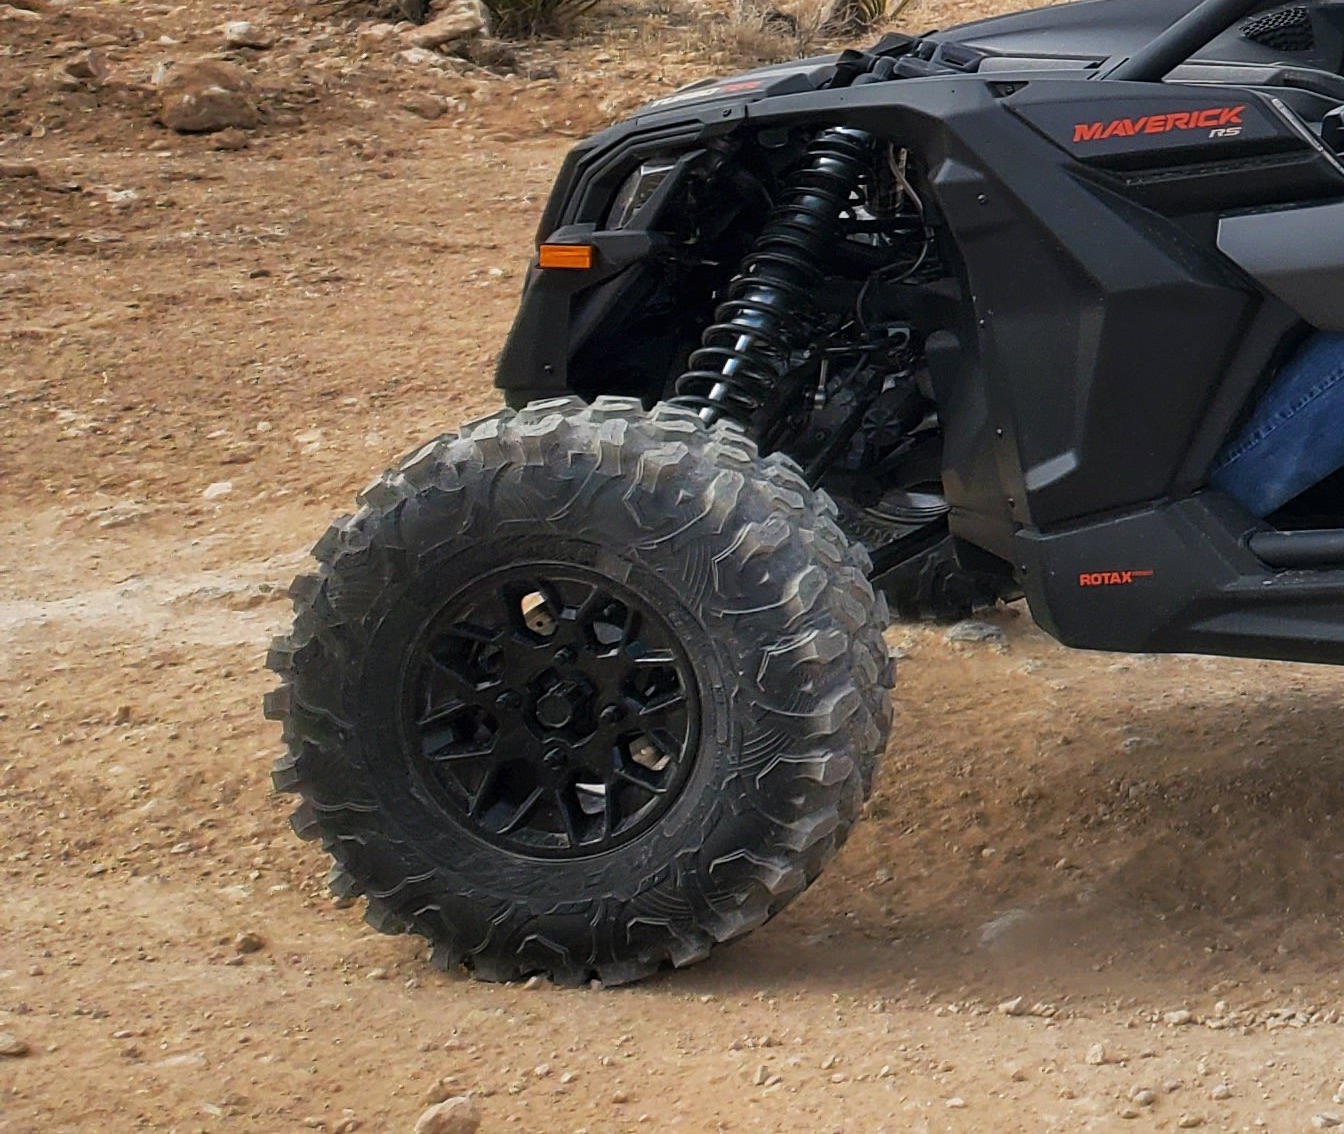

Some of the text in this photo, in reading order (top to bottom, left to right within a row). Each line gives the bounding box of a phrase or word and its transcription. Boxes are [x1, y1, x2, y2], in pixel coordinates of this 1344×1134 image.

[1072, 106, 1246, 143] MAVERICK
[1208, 126, 1243, 139] RS
[1080, 571, 1133, 586] ROTAX
